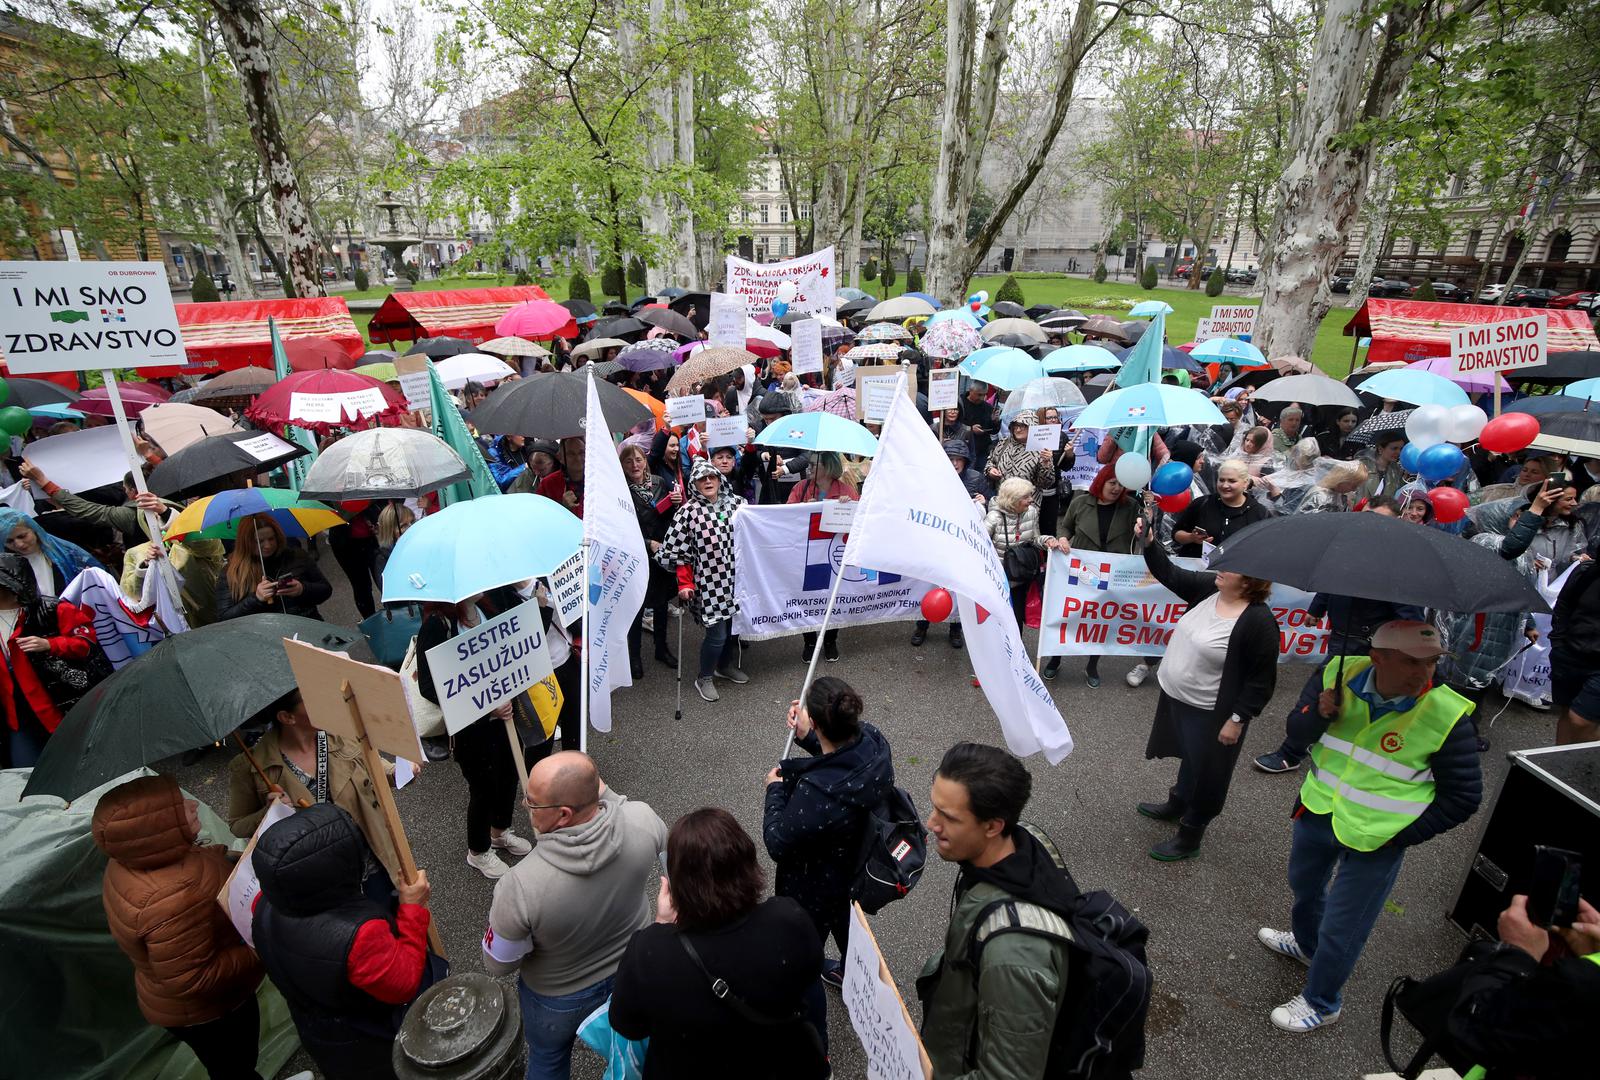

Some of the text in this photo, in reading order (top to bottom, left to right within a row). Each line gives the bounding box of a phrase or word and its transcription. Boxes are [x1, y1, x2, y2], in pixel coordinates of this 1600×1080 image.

[13, 285, 147, 306] I MI SMO
[1215, 308, 1254, 319] I MI SMO
[1211, 321, 1252, 333] ZDRAVSTVO
[1458, 321, 1539, 349] I MI SMO
[5, 328, 177, 354] ZDRAVSTVO
[1458, 343, 1540, 372] ZDRAVSTVO
[554, 571, 575, 590] MOJA
[561, 581, 581, 600] MOJE
[786, 588, 911, 609] HRVATSKI TRUKOVNI SINDIKAT
[1062, 597, 1189, 624] PROSVJE
[752, 608, 802, 626] MEDICINSKIH
[848, 601, 896, 614] MEDICINSKIH
[898, 599, 922, 609] TEHN
[457, 615, 521, 661] SESTRE
[1059, 622, 1068, 644] I
[1075, 623, 1109, 644] MI
[443, 631, 542, 699] ZASLUŽUJU
[472, 665, 530, 710] VIŠE!!!
